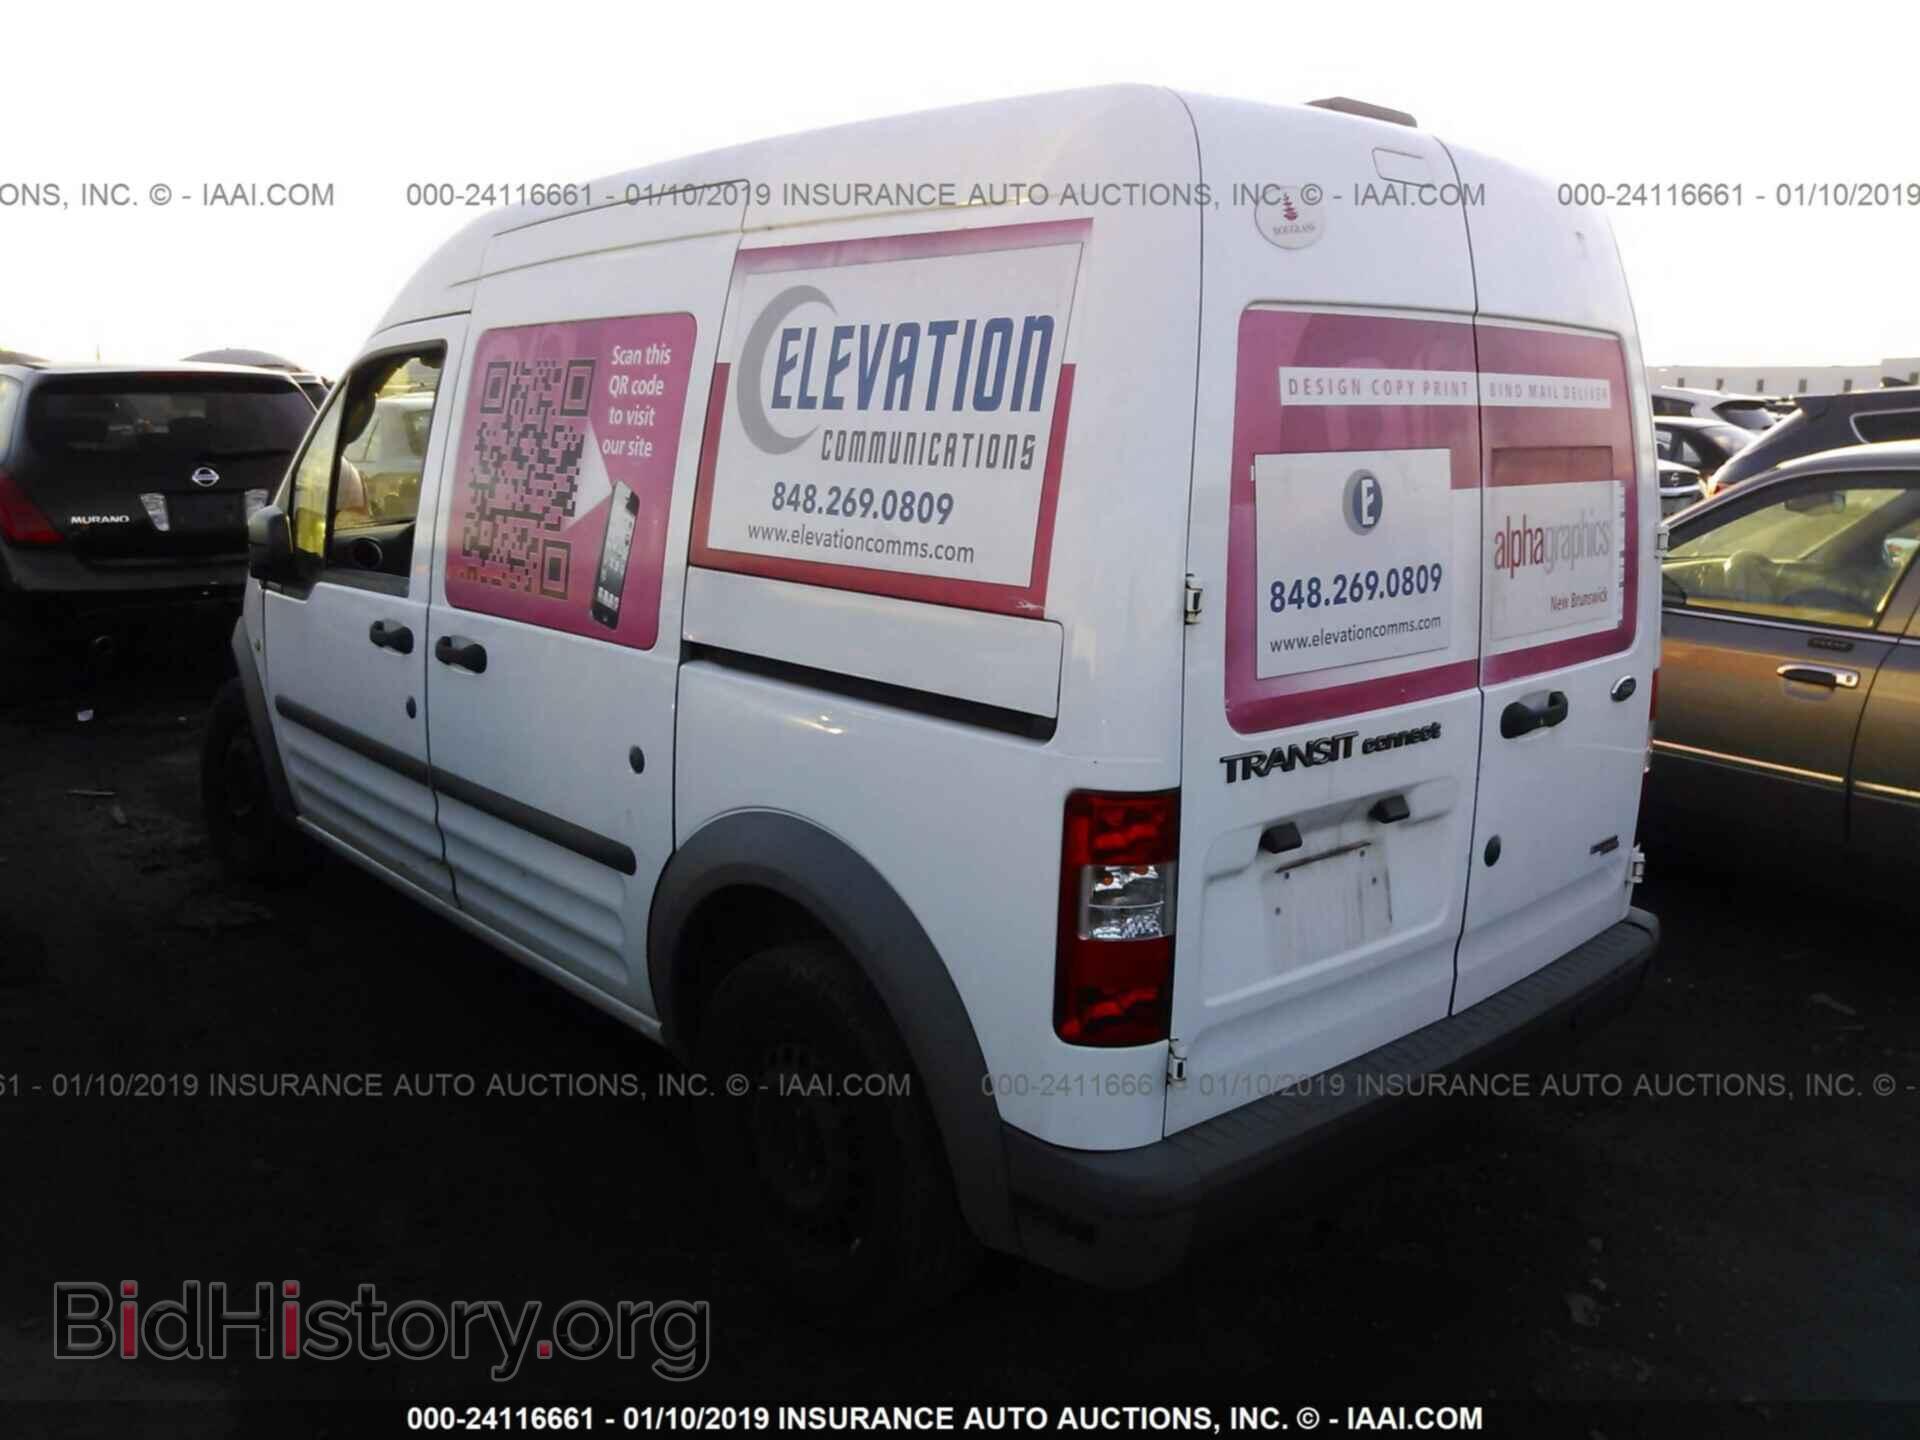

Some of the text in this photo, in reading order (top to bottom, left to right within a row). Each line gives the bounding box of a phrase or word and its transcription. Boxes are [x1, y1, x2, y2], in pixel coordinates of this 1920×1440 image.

[611, 343, 672, 366] Scan this
[608, 374, 664, 398] QR code
[1288, 377, 1362, 396] DESIGN
[1371, 379, 1415, 397] COPY
[1423, 380, 1469, 398] PRINT
[609, 404, 656, 427] to visit
[602, 435, 653, 457] our site
[772, 481, 954, 525] 848.269.0809
[71, 515, 130, 524] MURANO
[748, 523, 975, 564] www.elevationcomms.com
[1494, 507, 1611, 579] alphagraphics
[1270, 563, 1443, 613] 848.269.0809
[1270, 614, 1442, 653] www.elevationcomms.com
[1219, 721, 1442, 784] TRANSIT connect
